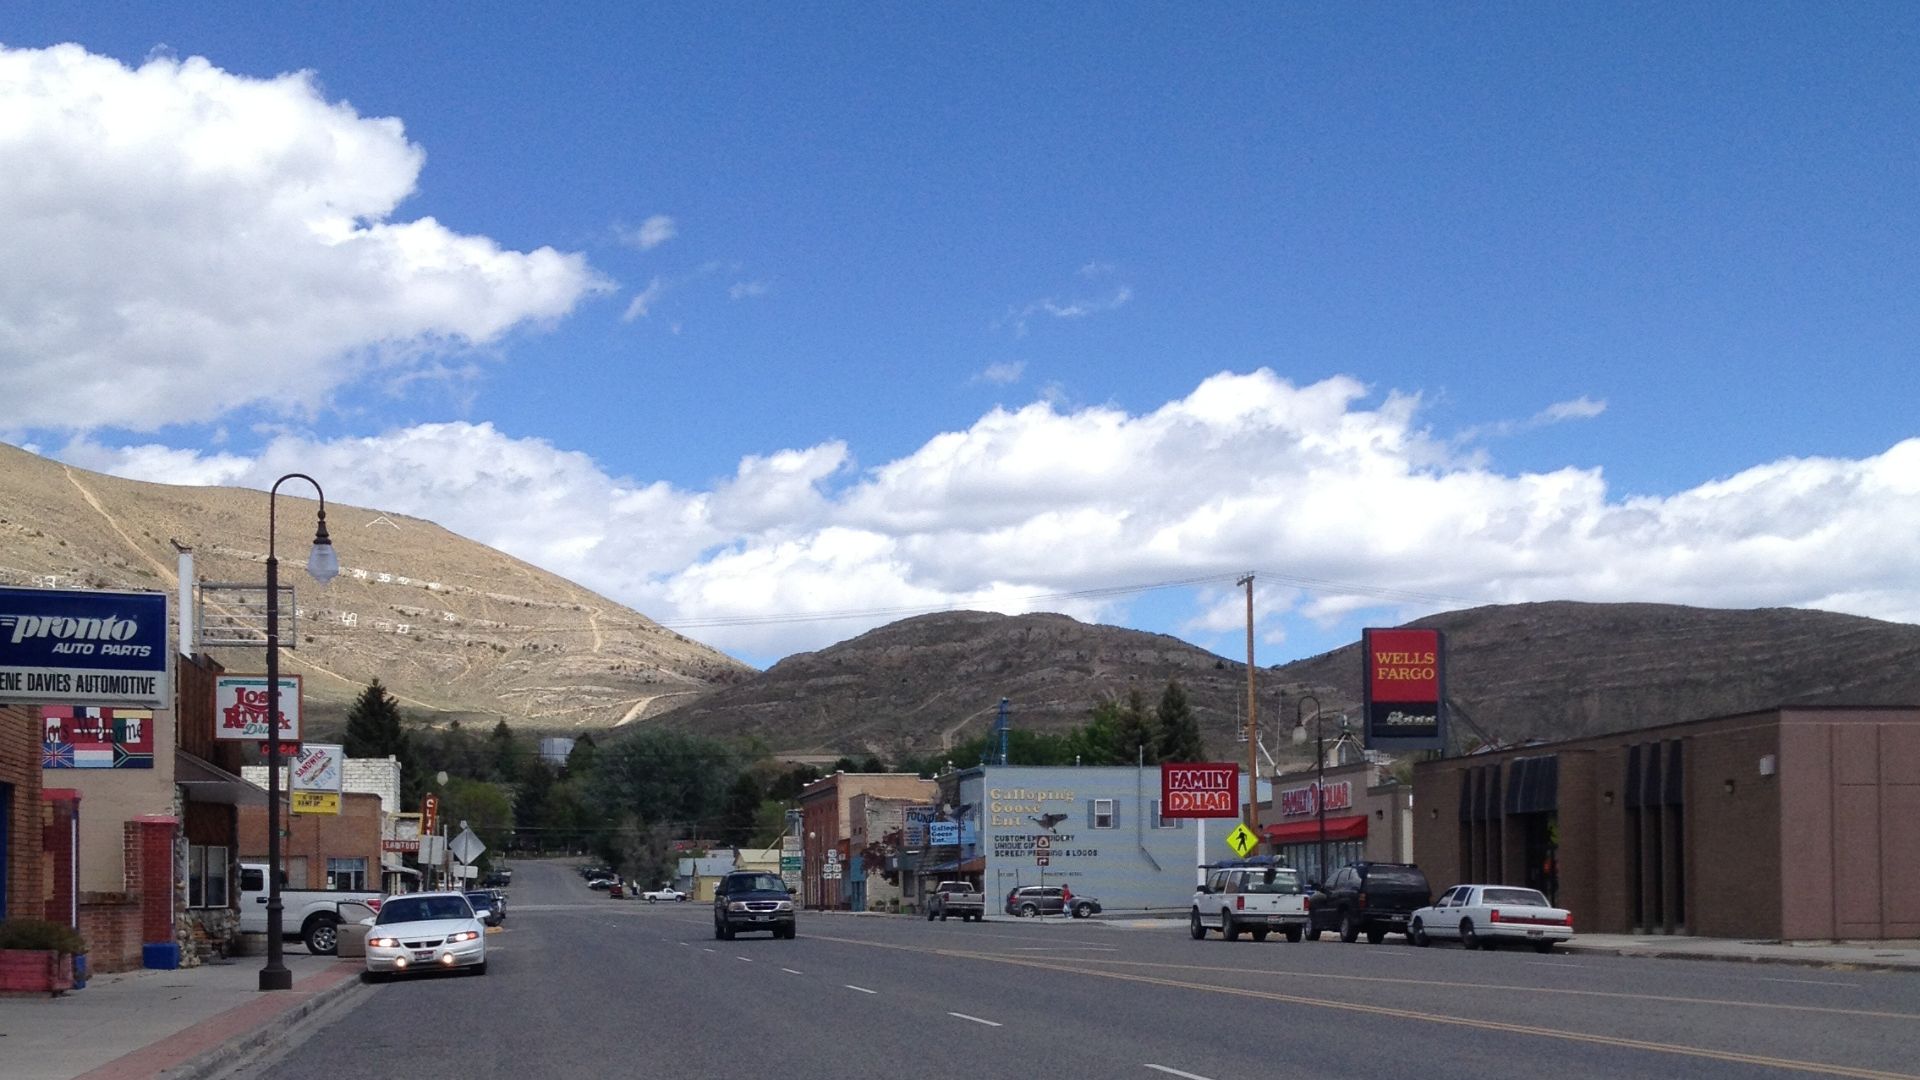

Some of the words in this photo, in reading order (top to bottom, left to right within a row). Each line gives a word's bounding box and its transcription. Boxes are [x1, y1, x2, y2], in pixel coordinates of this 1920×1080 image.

[10, 615, 138, 643] pronto
[52, 643, 94, 654] AUTO
[101, 644, 152, 657] PARTS
[1376, 652, 1435, 664] WELLS
[1377, 668, 1435, 680] FARGO
[27, 673, 71, 692] DAVIES
[76, 674, 156, 695] AUTOMOTIVE
[294, 749, 327, 778] SANDWICH
[1169, 770, 1232, 789] FAMILY
[990, 788, 1075, 804] Galloping
[1169, 791, 1231, 811] DOLLAR
[991, 801, 1041, 813] Goose
[906, 811, 935, 823] FOUND
